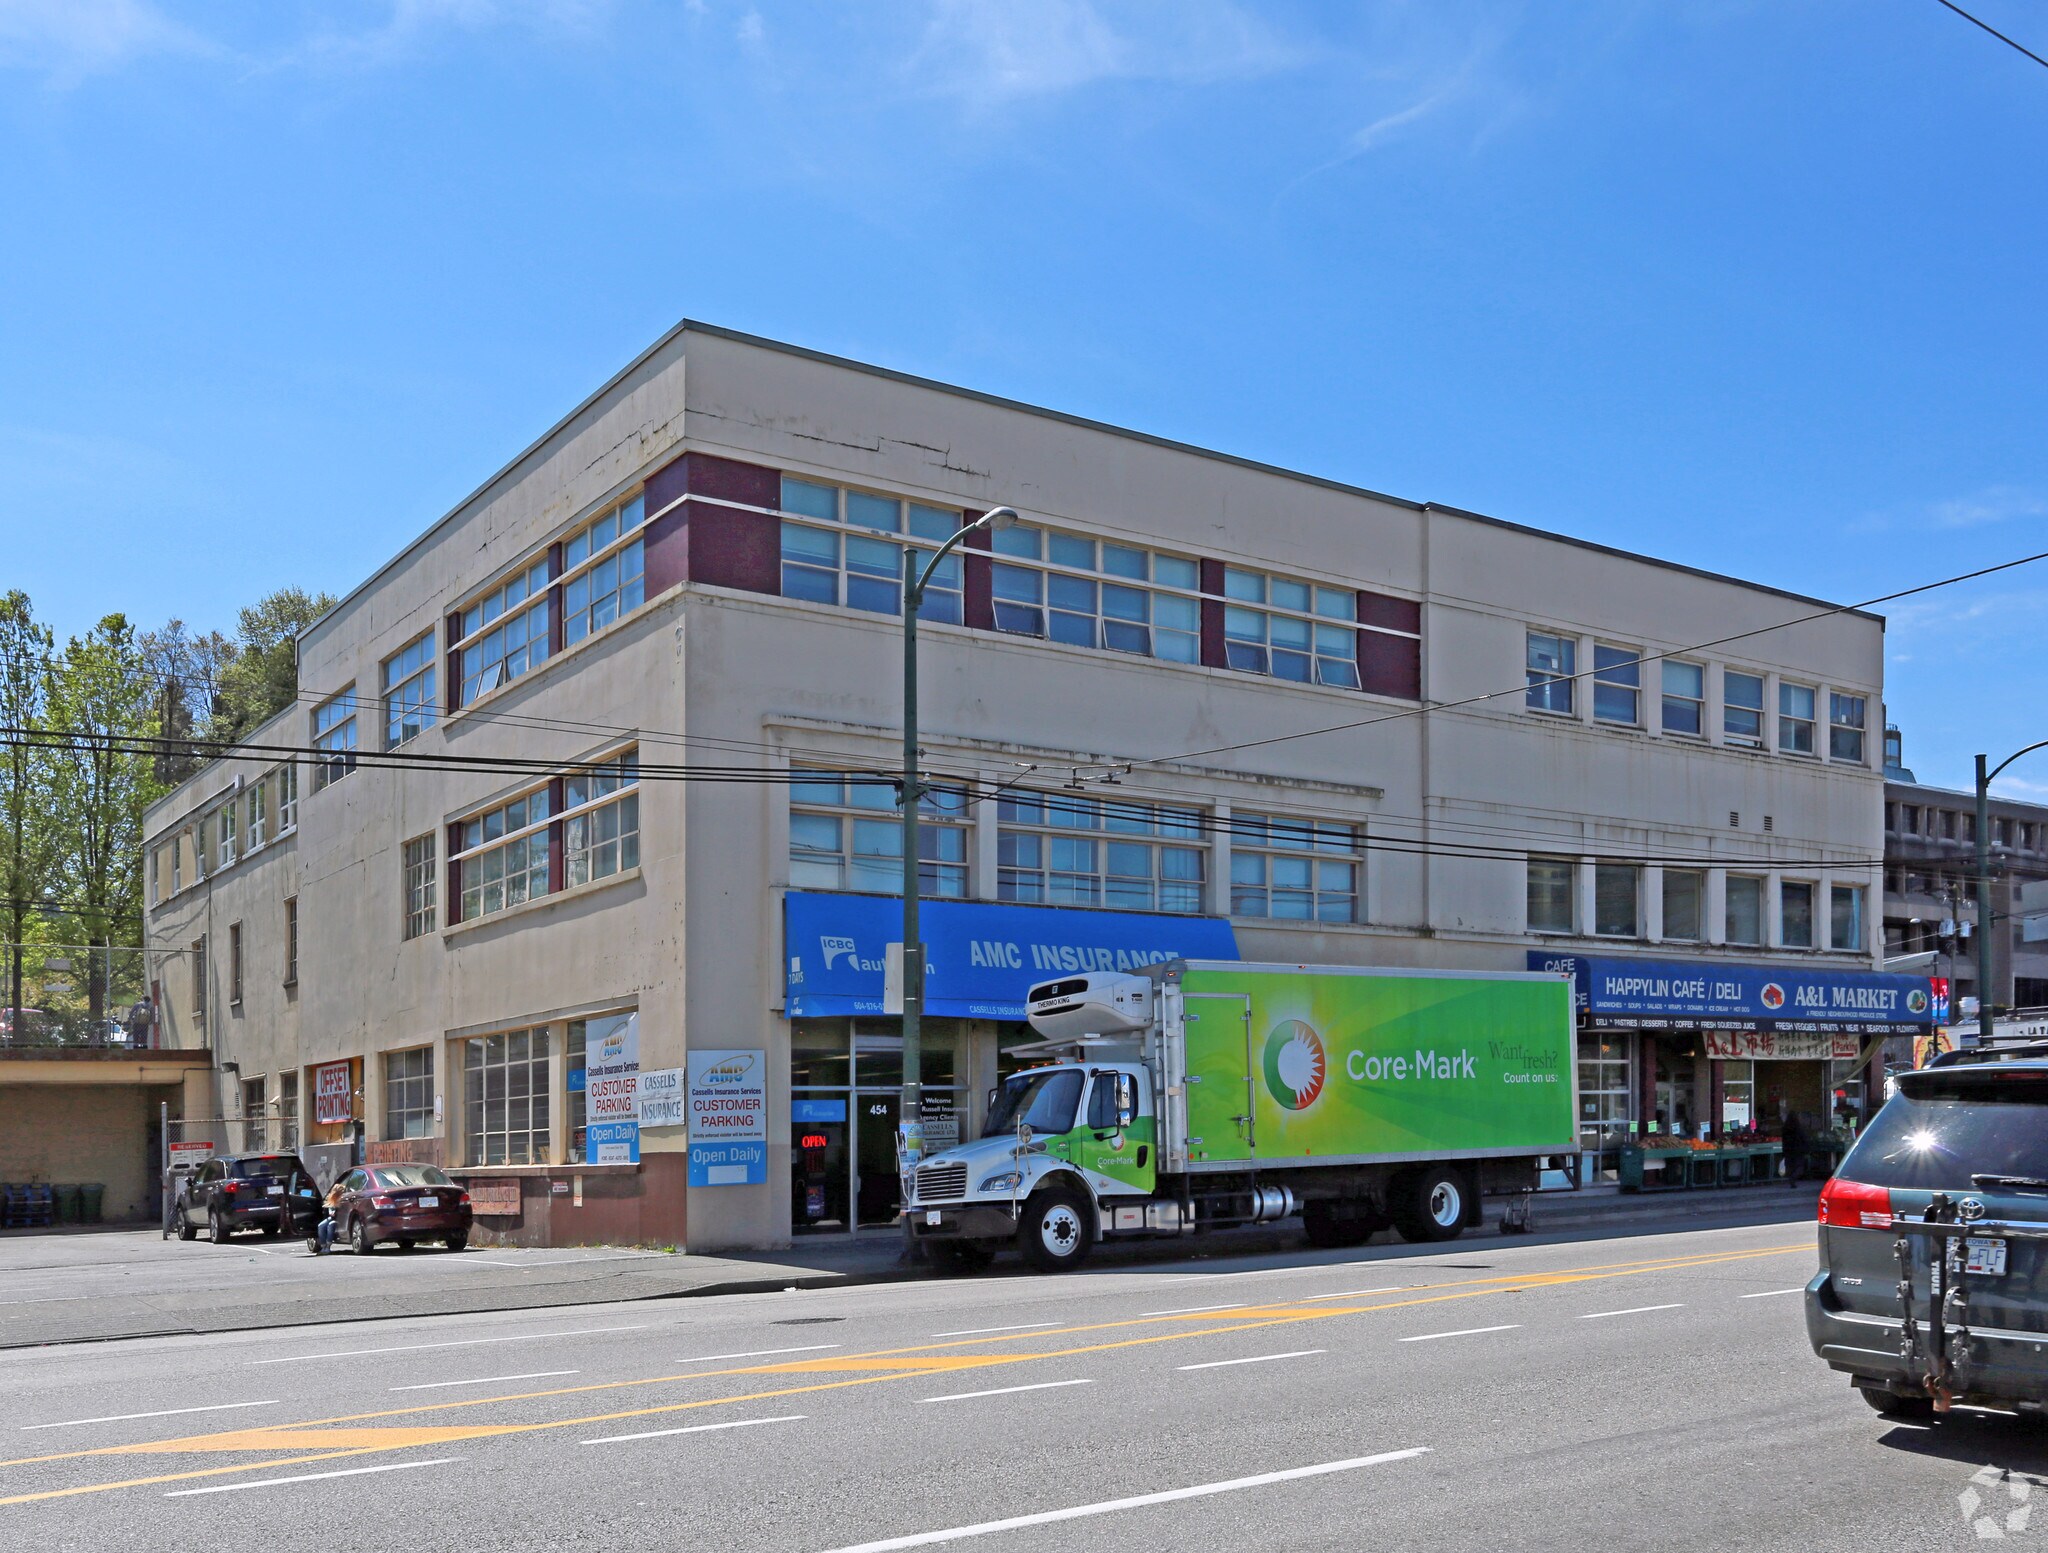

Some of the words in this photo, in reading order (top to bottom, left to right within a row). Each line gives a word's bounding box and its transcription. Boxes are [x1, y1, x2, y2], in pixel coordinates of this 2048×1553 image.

[823, 939, 854, 950] ICBC
[970, 940, 1022, 969] AMC
[1544, 958, 1575, 973] CAFE
[1606, 977, 1669, 997] HAPPYLIN
[1672, 977, 1705, 999] CAFÉ
[1716, 982, 1742, 1000] DELI
[1037, 999, 1058, 1009] THERMO
[1058, 996, 1070, 1005] KING
[1795, 985, 1828, 1007] A&L
[1832, 986, 1898, 1010] MARKET
[969, 1005, 997, 1015] CASSELLS
[997, 1006, 1026, 1016] INSURANC
[1596, 1018, 1608, 1026] DELI
[1614, 1018, 1638, 1027] PASTRIES
[1641, 1019, 1668, 1028] DESSERTS
[1674, 1020, 1694, 1028] COFFEE
[1700, 1021, 1717, 1029] FRESH
[1717, 1021, 1742, 1029] SQUEEZED
[1743, 1022, 1757, 1030] JUICE
[1775, 1021, 1794, 1031] FRESH
[1794, 1022, 1817, 1032] VEGGIES
[1820, 1023, 1839, 1032] FRUITS
[1845, 1024, 1859, 1032] MEAT
[1866, 1024, 1890, 1033] SEAFOOD
[1488, 1041, 1524, 1060] Want
[1521, 1050, 1559, 1070] fresh?
[588, 1065, 604, 1077] Cassells
[604, 1063, 623, 1075] Insurance
[320, 1066, 348, 1094] OFFSET
[644, 1073, 677, 1091] CASSELLS
[1503, 1072, 1530, 1084] Count
[1532, 1074, 1543, 1083] on
[591, 1078, 637, 1097] CUSTOMER
[692, 1088, 714, 1096] Cassells
[714, 1088, 740, 1096] Insurance
[740, 1087, 762, 1095] Services
[318, 1091, 351, 1119] PRINTING
[596, 1096, 632, 1114] PARKING
[693, 1098, 761, 1112] CUSTOMER
[925, 1097, 952, 1105] Welcome
[641, 1100, 681, 1121] INSURANCE
[869, 1104, 888, 1115] 454
[701, 1114, 754, 1128] PARKING
[591, 1126, 613, 1143] Open
[615, 1124, 637, 1142] Daily
[801, 1135, 828, 1148] OPEN
[692, 1148, 726, 1166] Open
[730, 1146, 761, 1164] Daily
[1930, 1260, 1941, 1295] THULE
